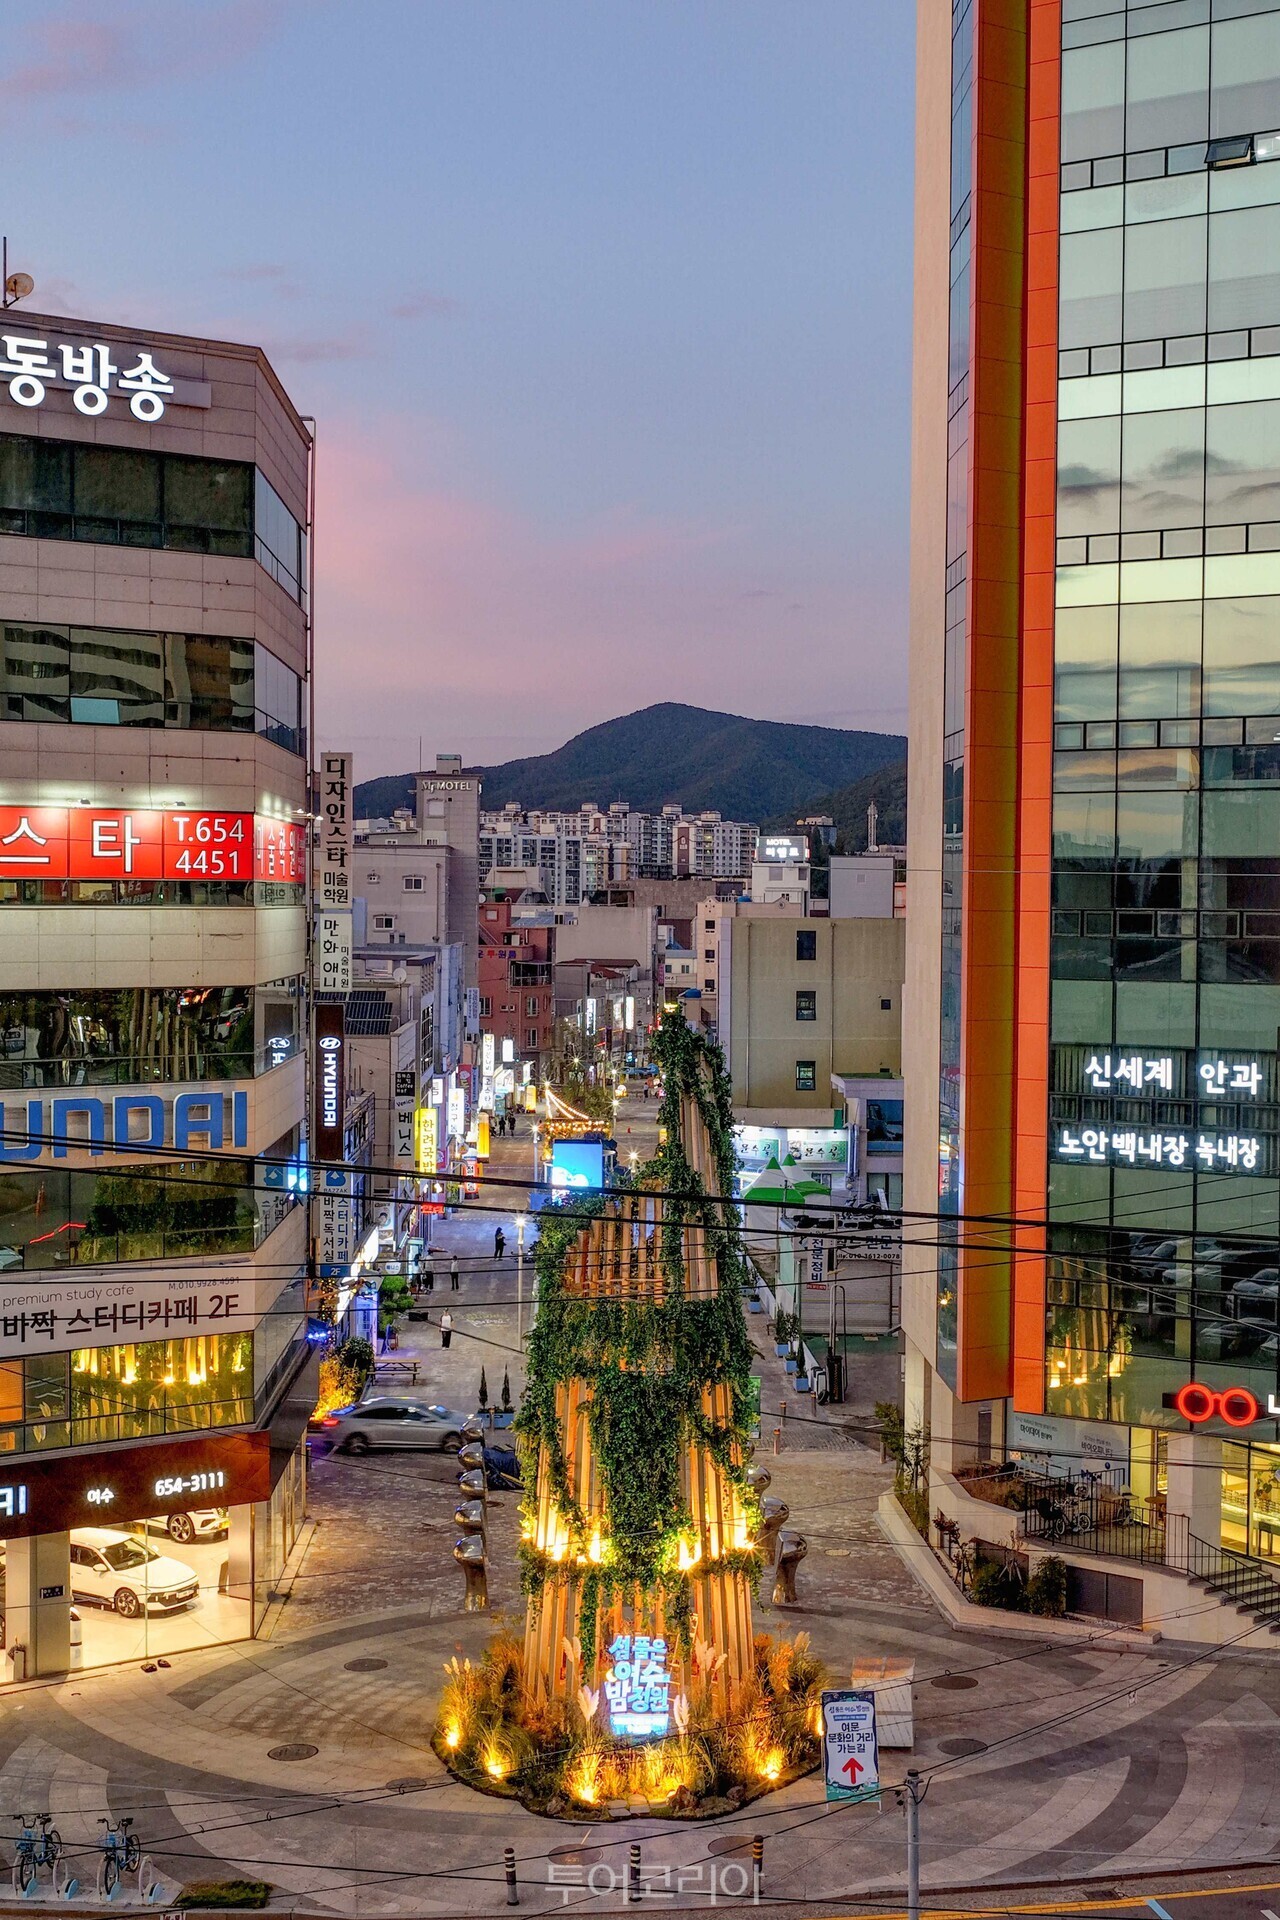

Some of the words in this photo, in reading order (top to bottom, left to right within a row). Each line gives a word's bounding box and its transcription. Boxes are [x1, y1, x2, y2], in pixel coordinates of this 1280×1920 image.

[0, 335, 174, 422] 동방송
[437, 781, 472, 790] MOTEL
[172, 817, 244, 843] T.654
[325, 758, 349, 868] 디자인스타
[0, 815, 142, 874] 스타
[766, 838, 792, 846] MOTEL
[175, 849, 240, 875] 4451
[323, 919, 340, 988] 만화애니
[323, 1053, 337, 1127] HYUNDAI
[1085, 1055, 1172, 1090] 신세계
[1200, 1060, 1262, 1095] 안과
[397, 1111, 413, 1157] 베니스
[1196, 1135, 1260, 1169] 녹내장
[323, 1195, 335, 1263] 바짝독서실
[337, 1197, 349, 1262] 스터디카페
[330, 1267, 341, 1276] 2F
[811, 1238, 824, 1282] 전문정비
[3, 1291, 62, 1310] premium
[67, 1287, 102, 1302] study
[106, 1285, 135, 1298] cafe
[3, 1308, 57, 1343] 바짝
[66, 1296, 198, 1335] 스터디카페
[209, 1294, 239, 1320] 2F
[86, 1488, 115, 1504] 여수
[155, 1471, 225, 1497] 654-3111
[614, 1660, 671, 1690] 여수
[828, 1732, 854, 1743] 문화의
[856, 1732, 874, 1743] 거리
[841, 1722, 859, 1732] 여문
